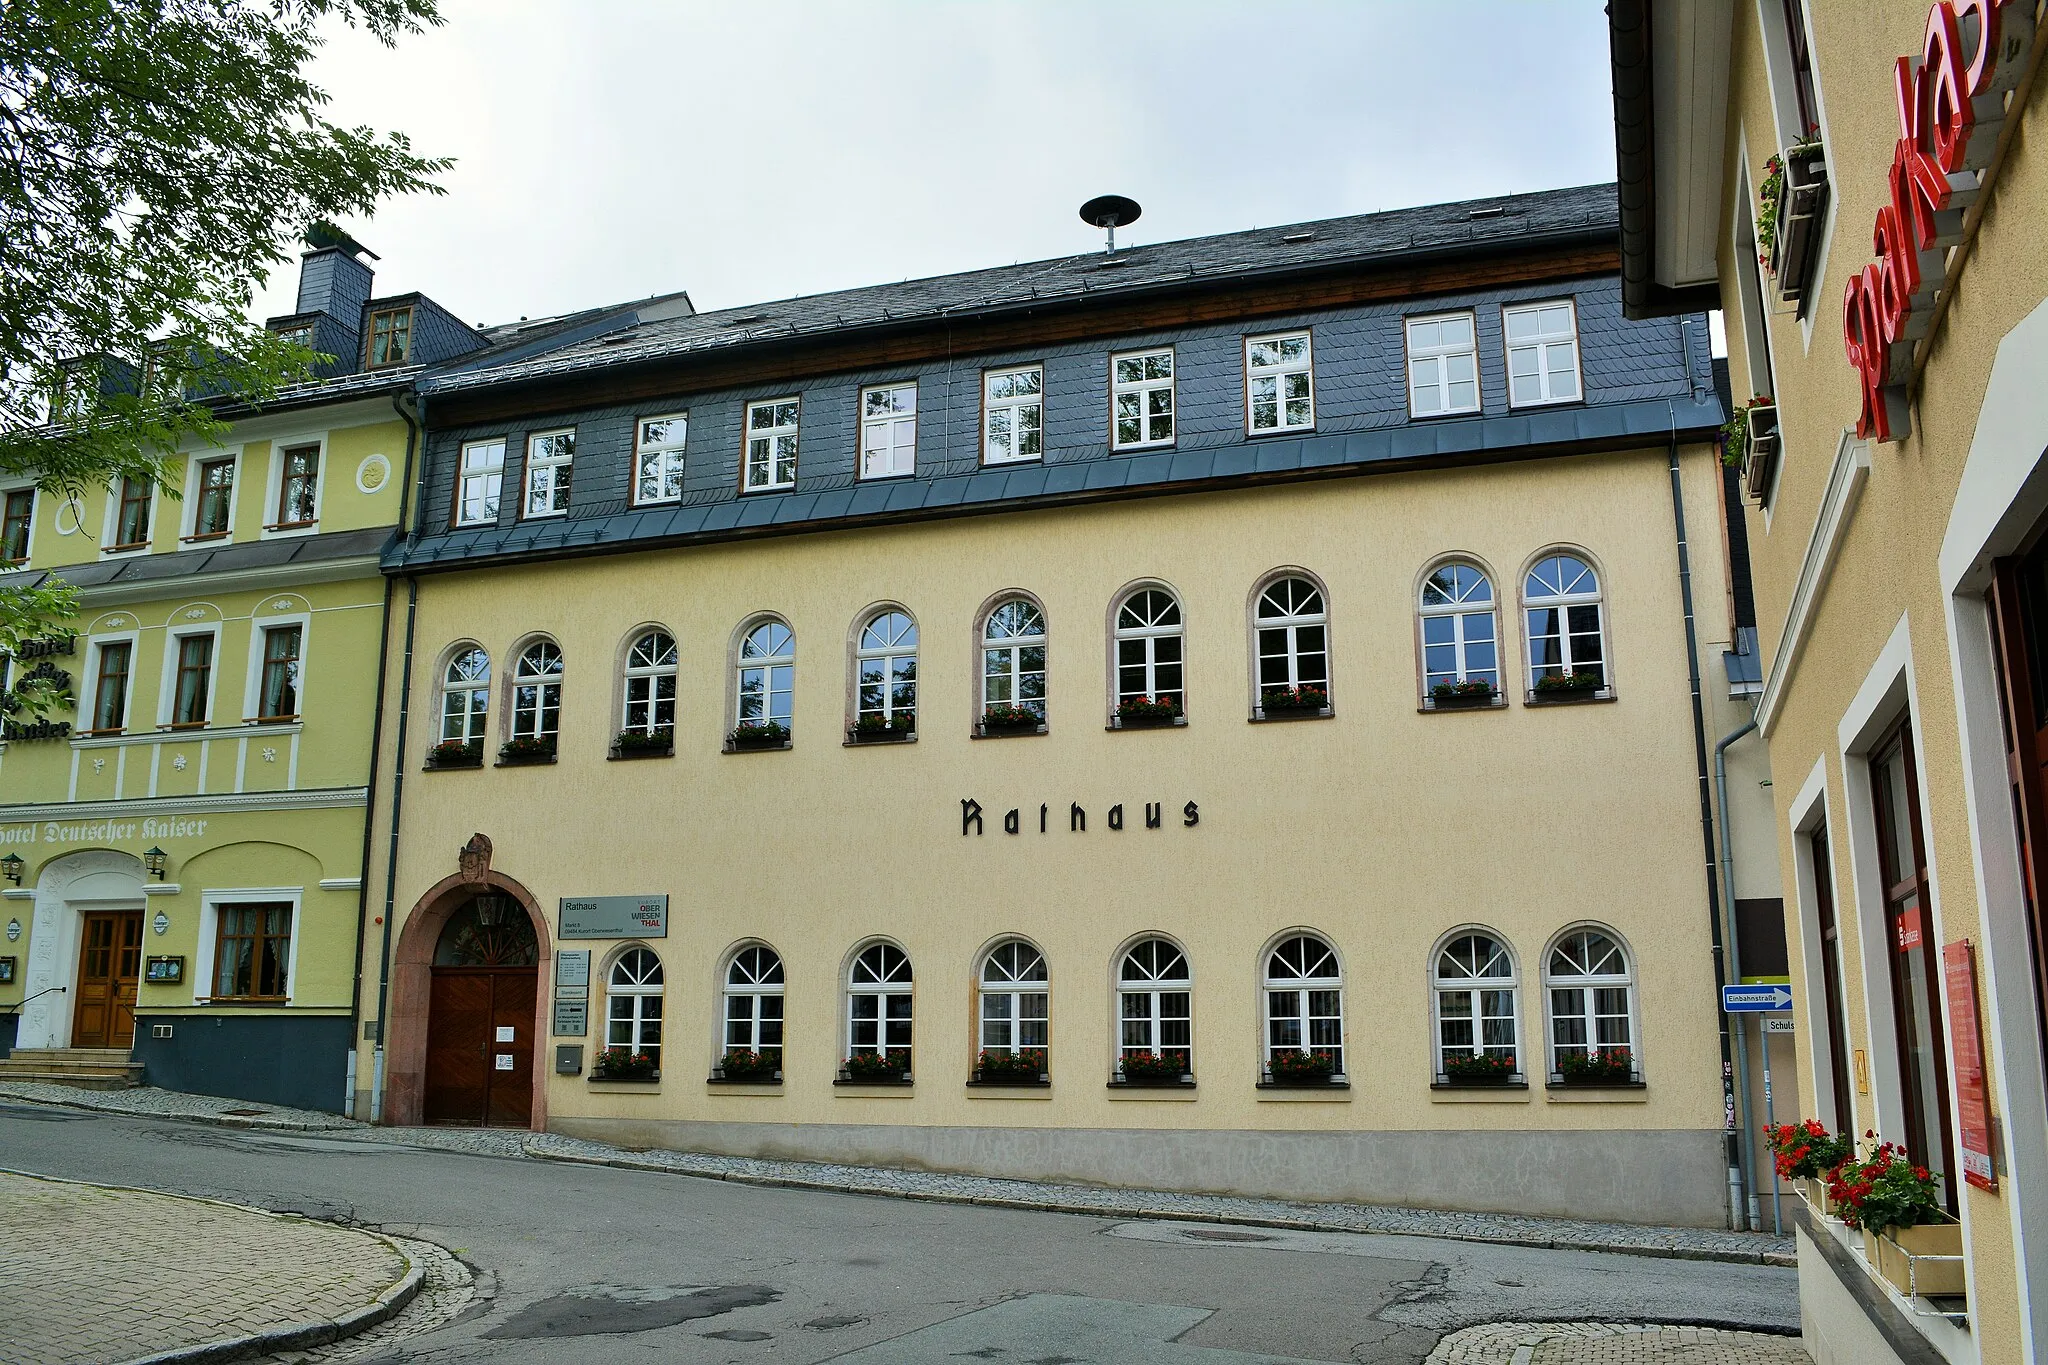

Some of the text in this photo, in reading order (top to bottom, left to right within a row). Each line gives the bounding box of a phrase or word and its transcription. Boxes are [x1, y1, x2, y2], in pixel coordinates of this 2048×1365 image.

[1842, 0, 2003, 444] Sparkas
[960, 797, 1199, 836] Rathaus
[44, 818, 136, 845] Deutscher
[142, 815, 208, 839] Kaiser
[565, 902, 597, 911] Rathaus
[631, 912, 660, 920] WIESEN
[640, 919, 660, 927] THAL
[1728, 994, 1777, 1002] Einbahnstraße
